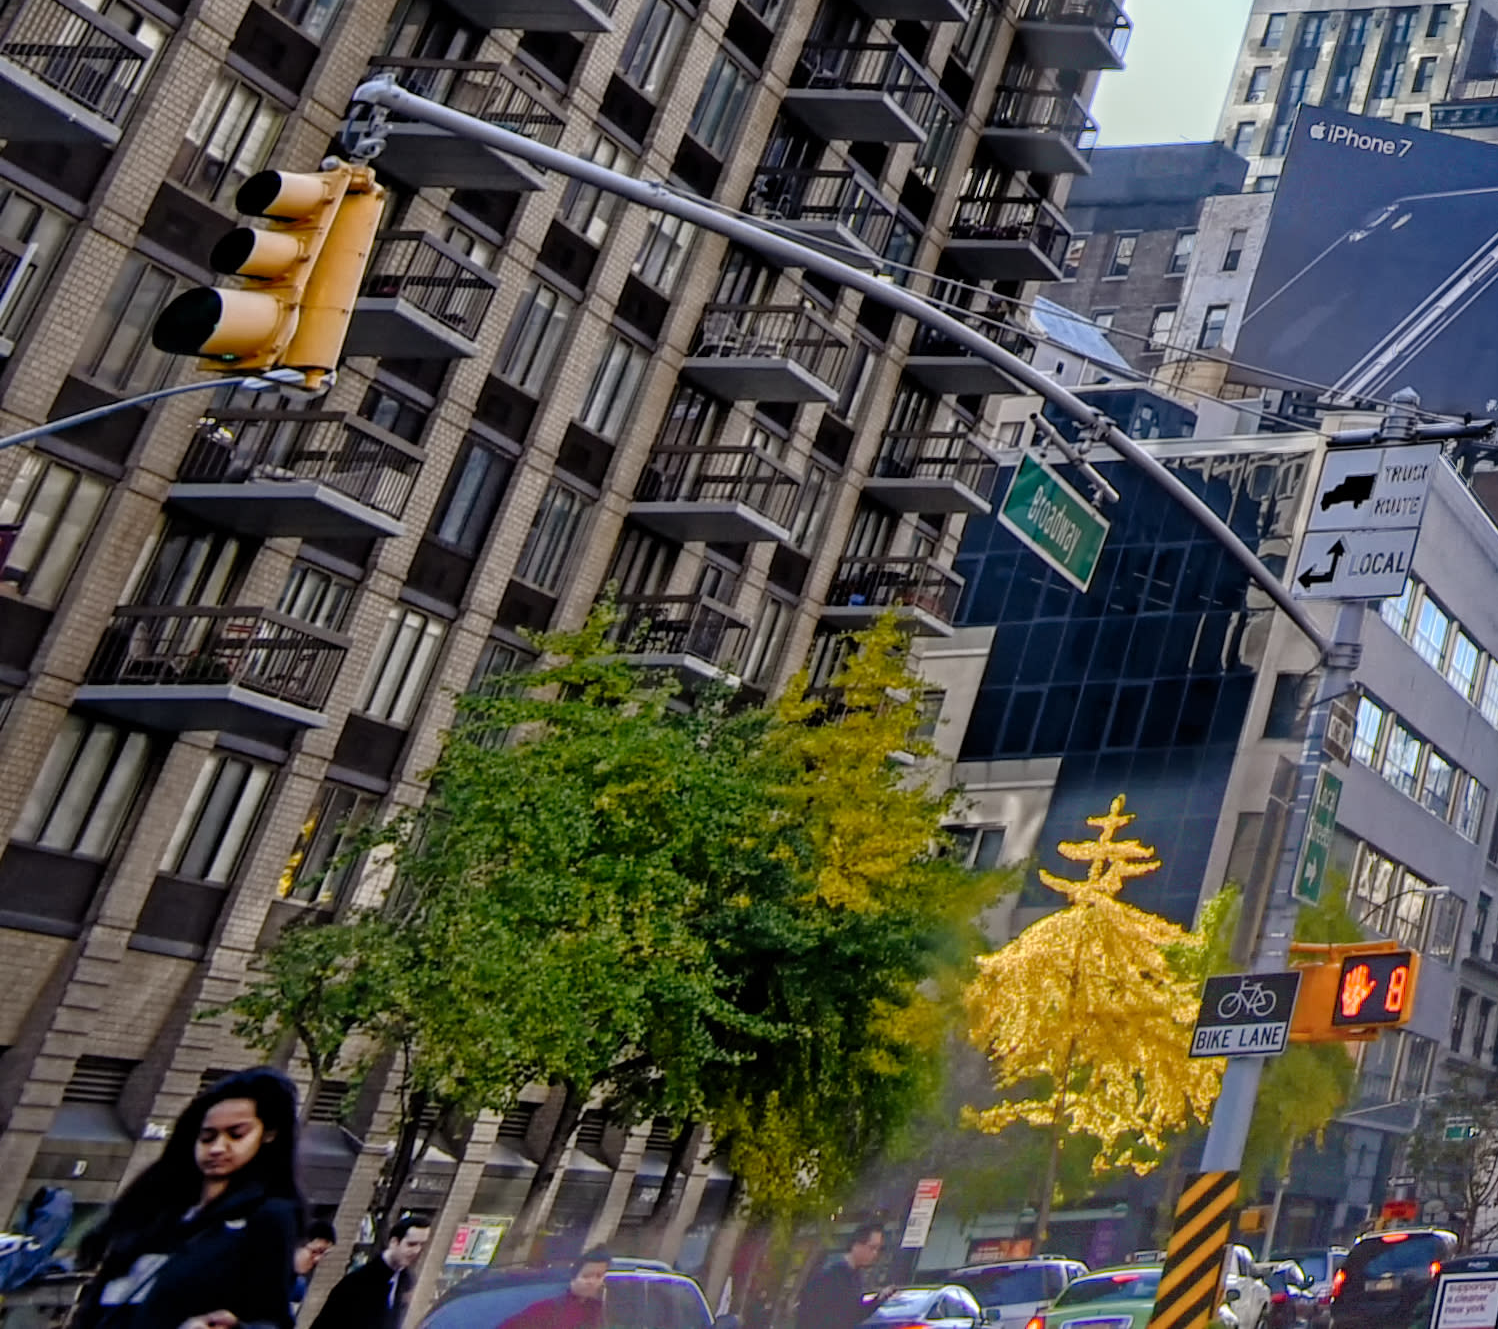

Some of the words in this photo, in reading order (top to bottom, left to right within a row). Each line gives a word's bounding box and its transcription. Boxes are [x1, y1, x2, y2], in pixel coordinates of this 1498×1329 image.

[1328, 124, 1396, 155] iPhone
[1398, 140, 1412, 157] 7
[1385, 465, 1428, 482] TRUCK
[1374, 497, 1420, 515] ROUTE
[1028, 485, 1082, 564] Broadway
[1348, 549, 1405, 577] LOCAL
[1384, 965, 1408, 1013] 8
[1196, 1029, 1233, 1050] BIKE
[1239, 1026, 1283, 1047] LANE
[1448, 1282, 1497, 1293] supporting
[1455, 1294, 1489, 1303] cleaner
